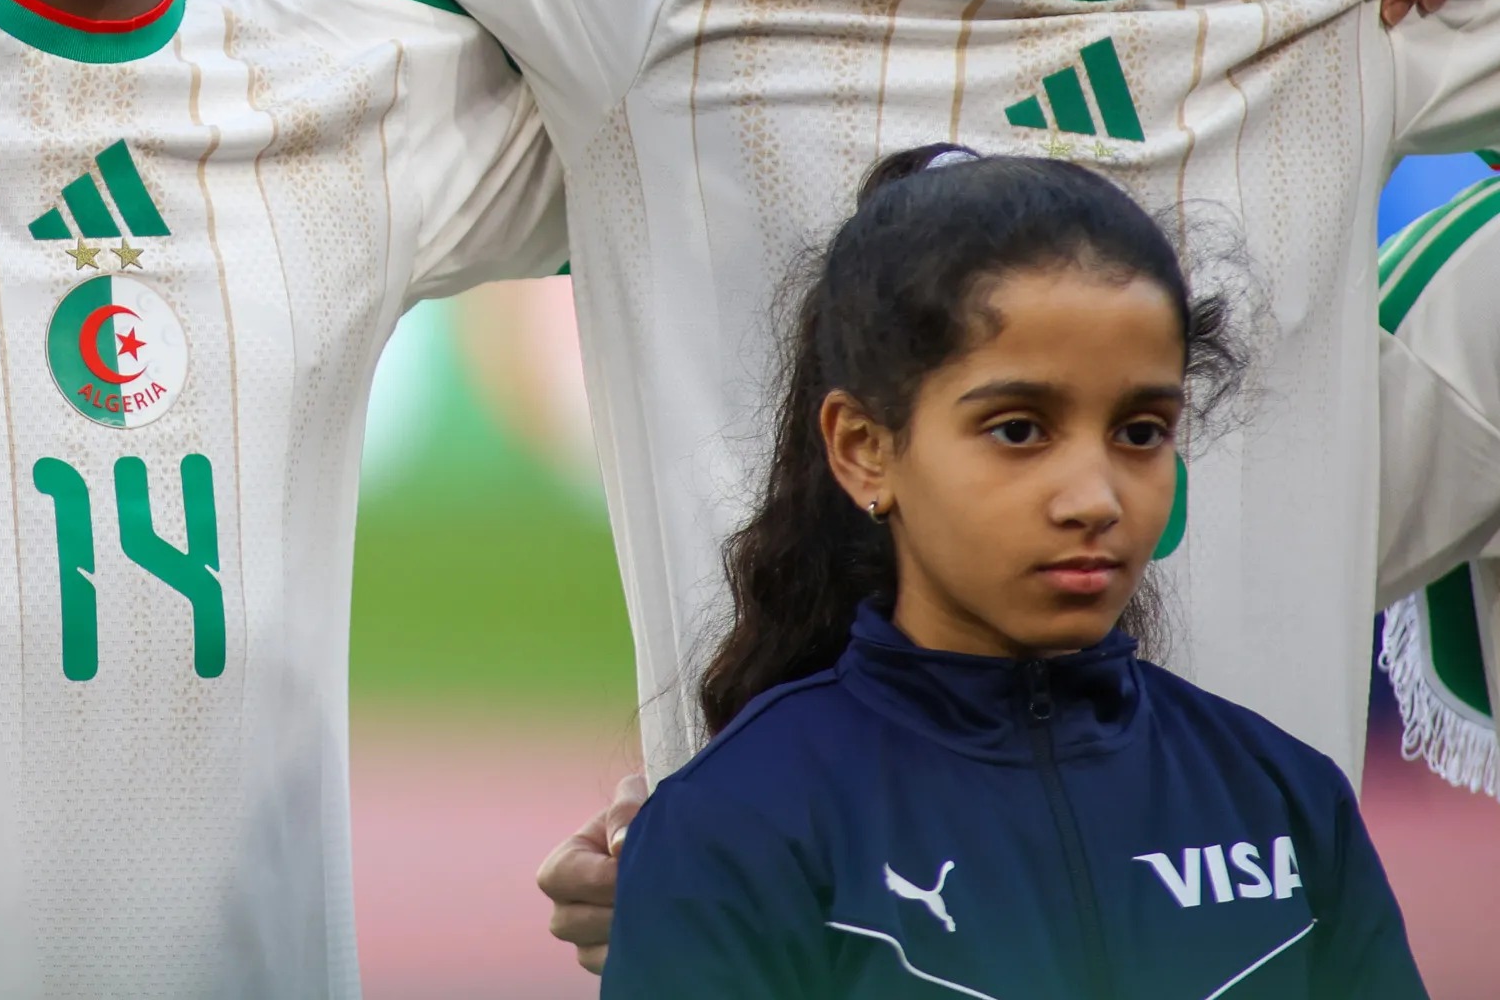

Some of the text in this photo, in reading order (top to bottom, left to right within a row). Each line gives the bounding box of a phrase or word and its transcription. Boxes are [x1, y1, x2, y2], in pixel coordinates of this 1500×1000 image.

[77, 382, 167, 413] ALGERIA
[33, 454, 226, 681] 14
[1132, 835, 1304, 908] VISA
